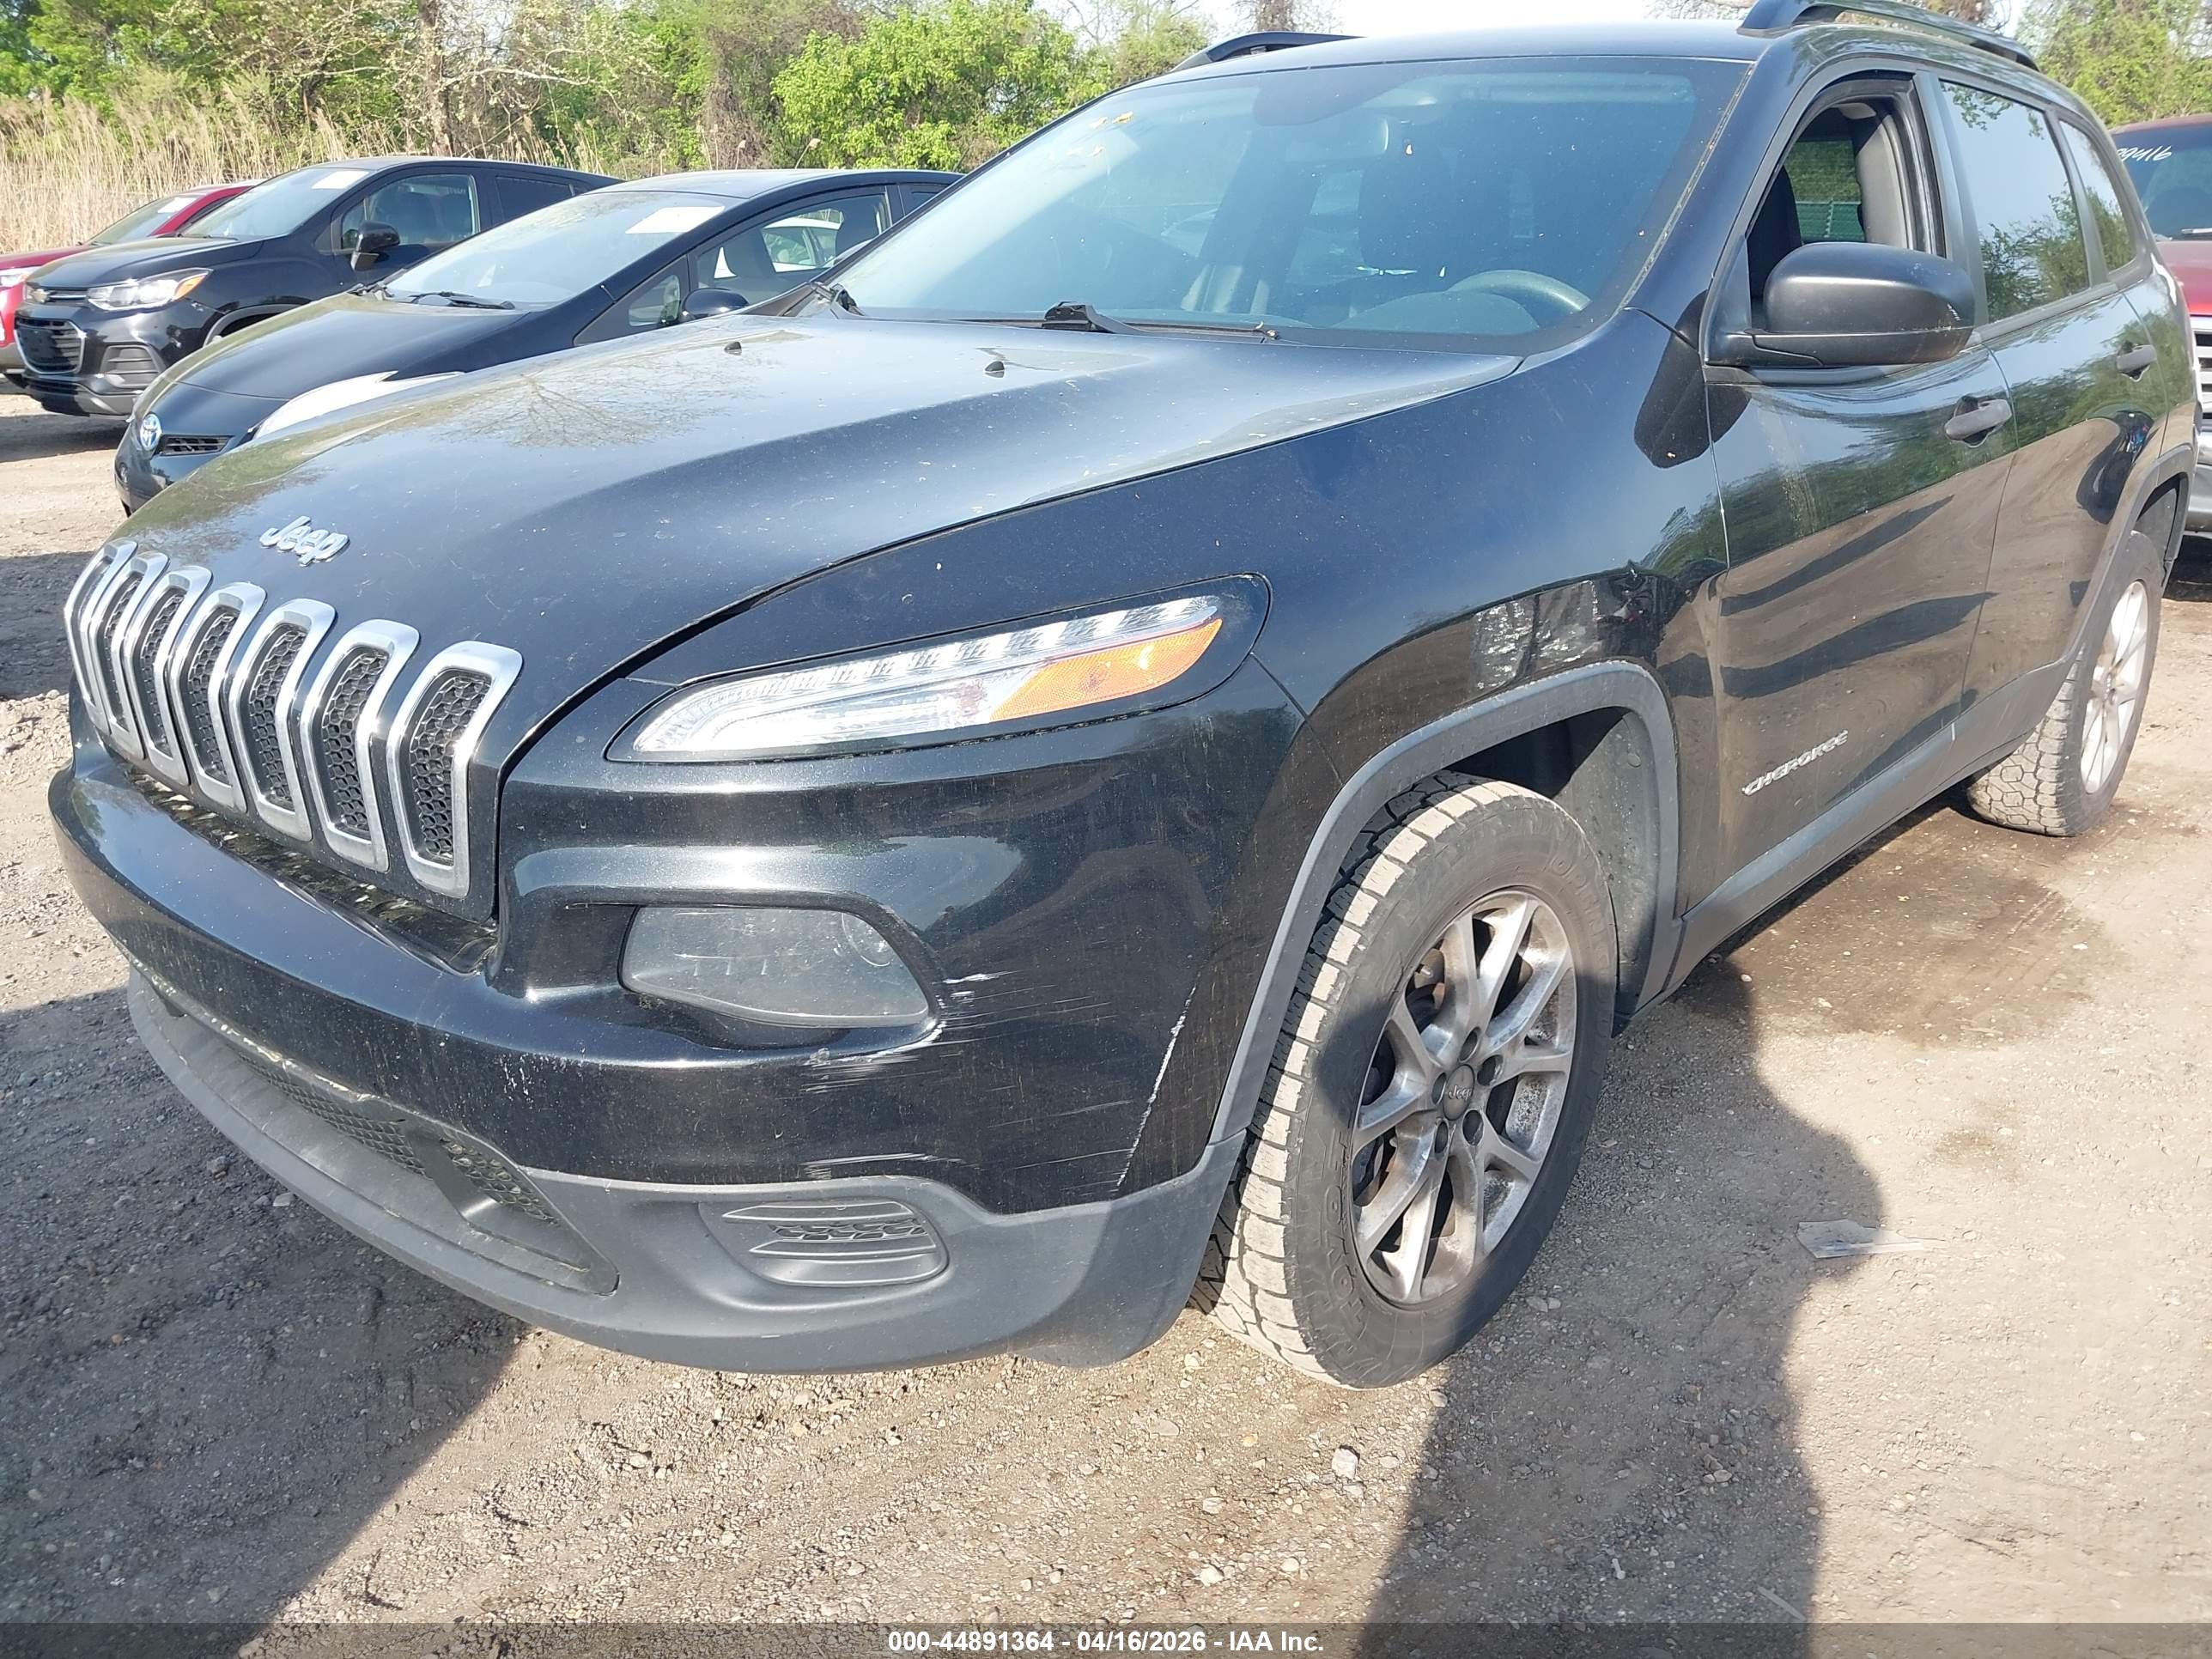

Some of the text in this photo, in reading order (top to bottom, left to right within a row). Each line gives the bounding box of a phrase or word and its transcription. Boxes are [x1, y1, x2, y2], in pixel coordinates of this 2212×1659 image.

[259, 515, 350, 567] Jeep
[1741, 728, 1849, 797] CHEROKEE
[1448, 1084, 1473, 1102] Jeep
